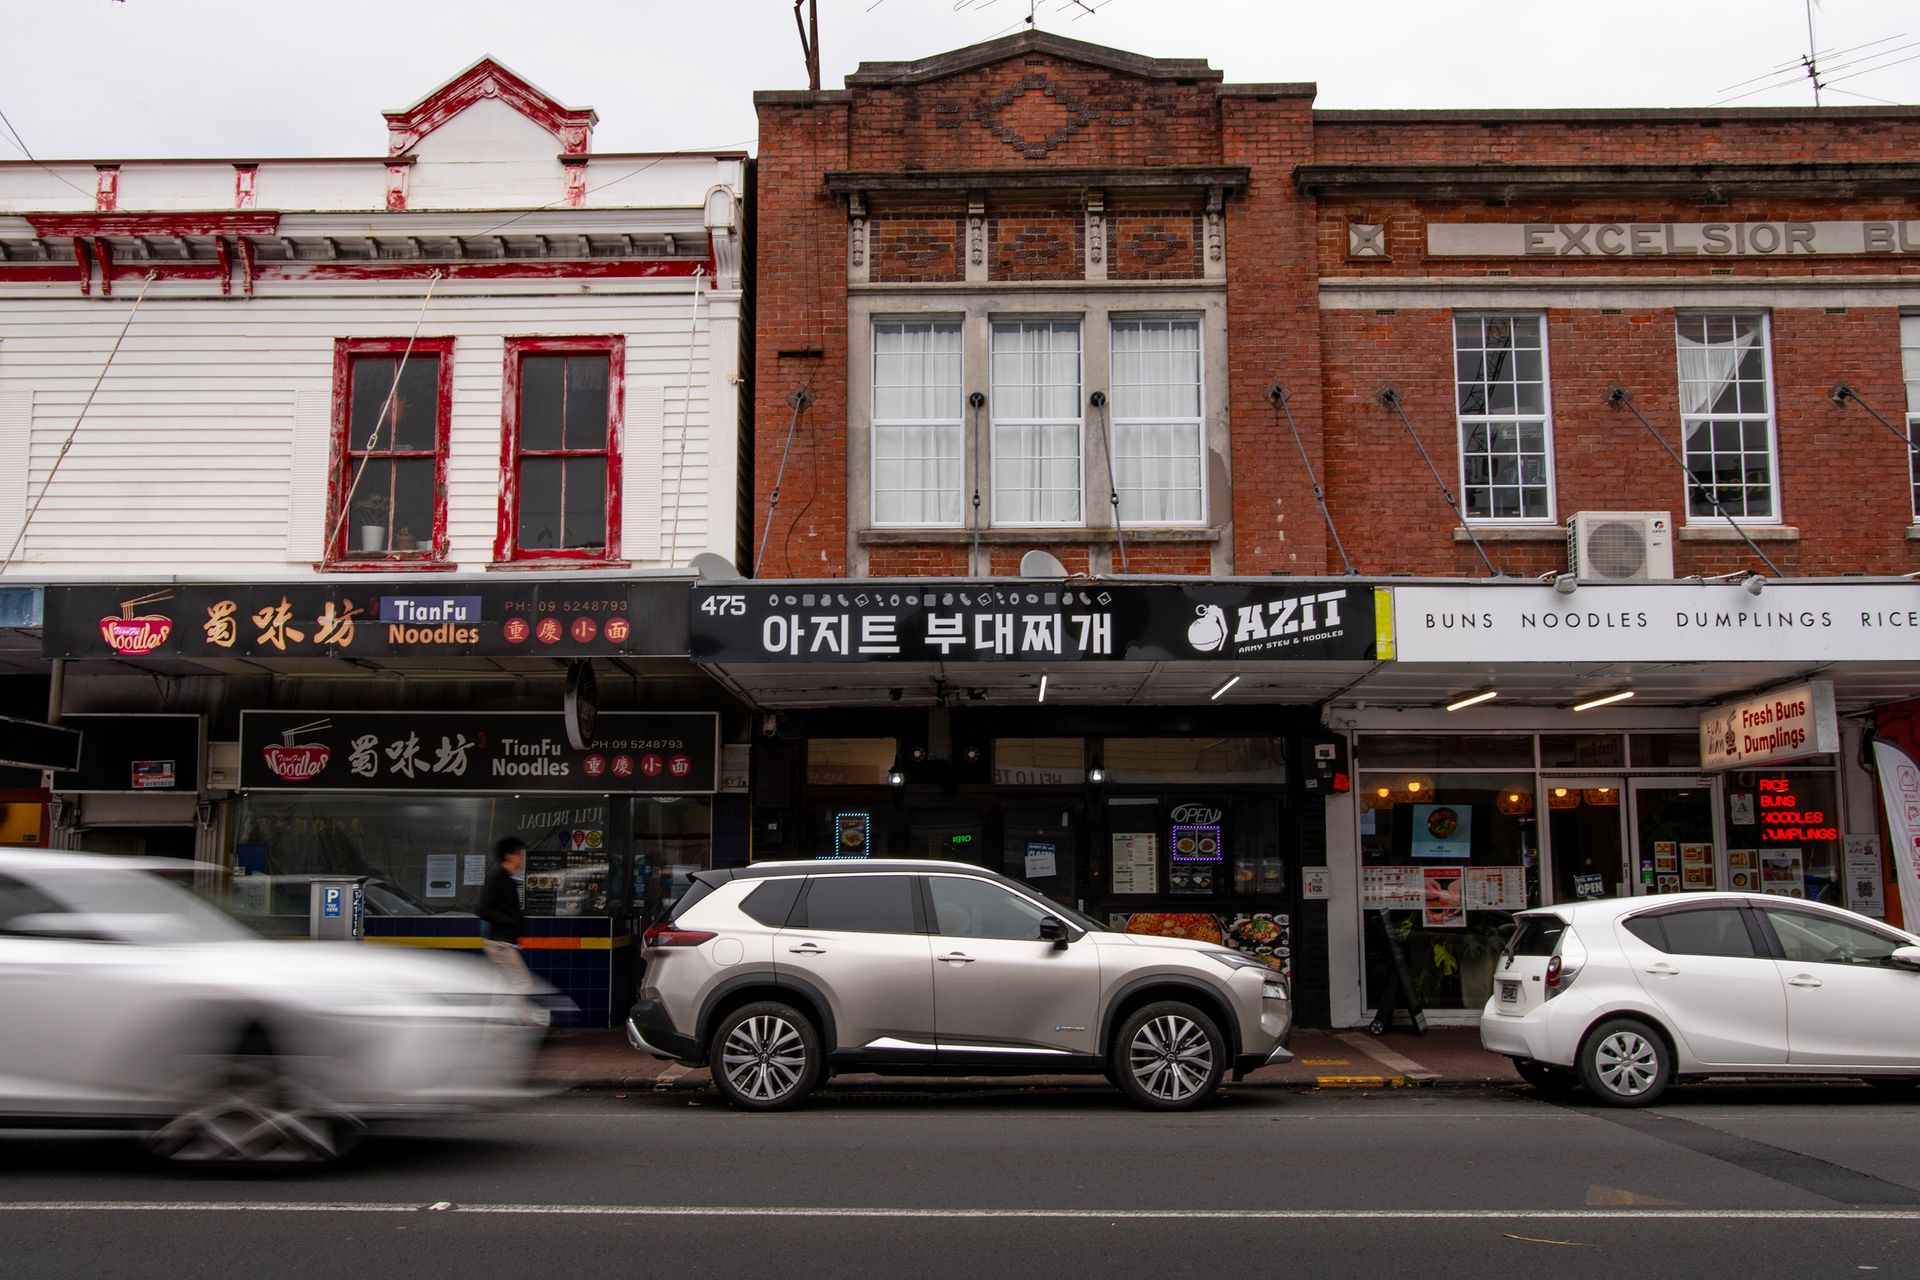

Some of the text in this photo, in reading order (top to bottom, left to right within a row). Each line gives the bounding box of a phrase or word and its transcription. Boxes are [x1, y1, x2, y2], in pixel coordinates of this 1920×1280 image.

[1524, 222, 1817, 256] EXCELSIOR
[394, 600, 467, 621] TianFu
[505, 601, 628, 612] PH: 09 5248793
[701, 595, 746, 616] 475
[1234, 589, 1347, 642] AZIT
[203, 595, 364, 650] 蜀味坊
[1426, 611, 1918, 629] BUNS NOODLES DUMPLINGS RICE
[102, 622, 171, 650] Noodles
[389, 624, 479, 645] Noodles
[763, 612, 1112, 655] 아지트 부대찌개
[1238, 629, 1344, 653] ARMY STEW & NOODLES
[1743, 701, 1805, 728] Fresh Buns
[501, 739, 561, 756] TianFu
[630, 739, 683, 749] 5248793
[1744, 727, 1805, 754] Dumplings
[265, 748, 328, 777] Noodles
[349, 731, 474, 779] 蜀味坊
[492, 759, 569, 776] Noodles
[1760, 779, 1790, 791] RICE
[1738, 802, 1748, 812] A
[1760, 795, 1796, 807] BUNS
[1175, 807, 1218, 823] OPEN
[327, 889, 339, 903] P
[1577, 882, 1603, 895] OPEN
